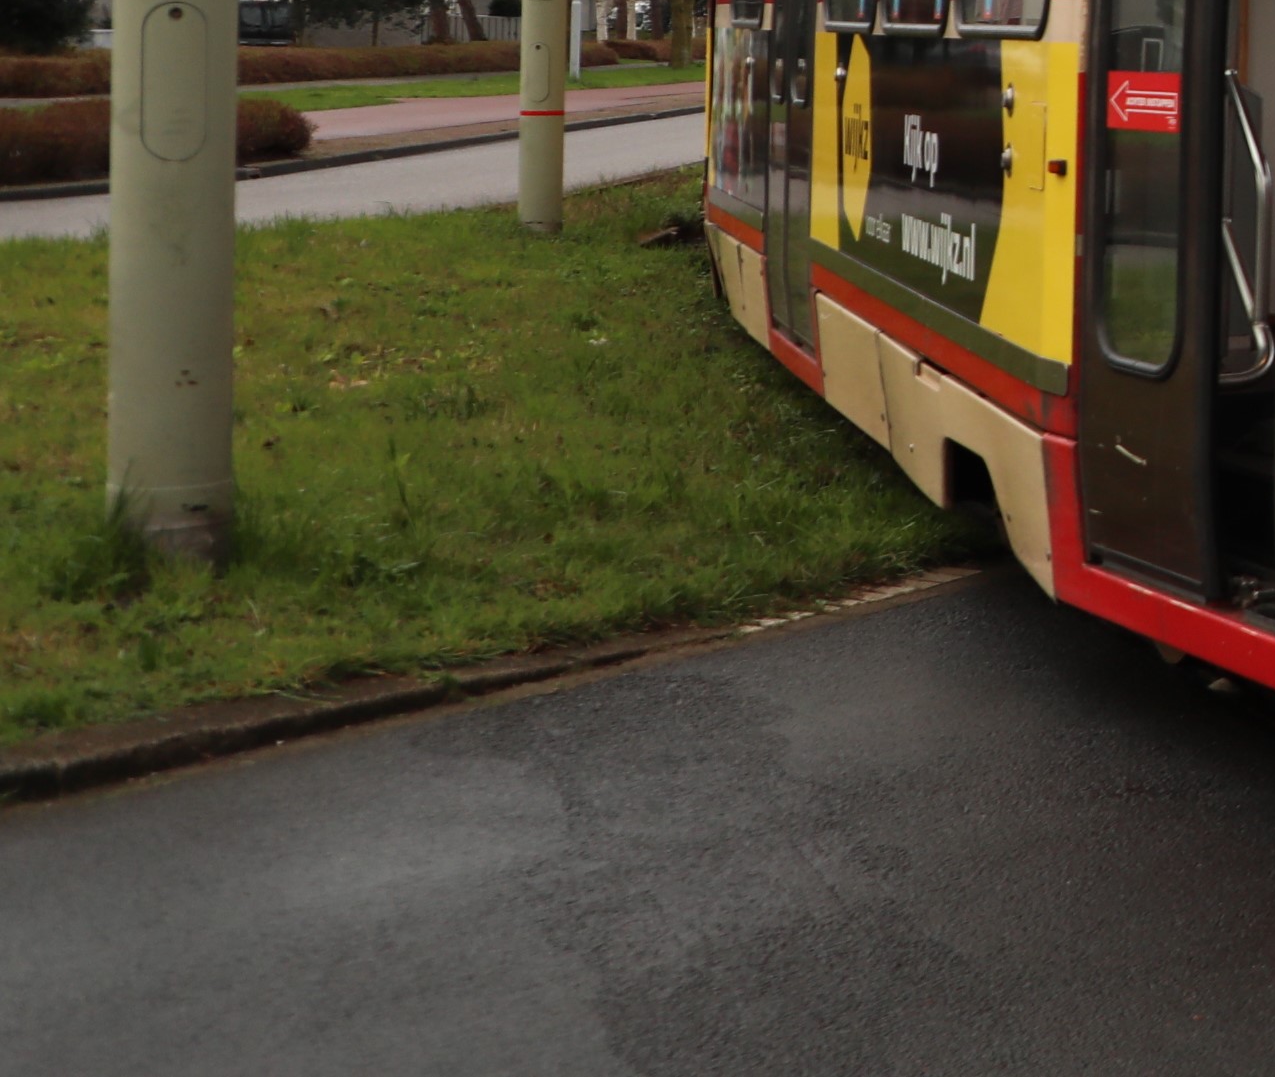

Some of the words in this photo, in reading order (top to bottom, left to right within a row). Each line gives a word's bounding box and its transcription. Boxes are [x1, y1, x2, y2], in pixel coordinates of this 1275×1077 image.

[903, 114, 923, 183] Kijk
[924, 131, 939, 189] op
[901, 211, 976, 285] www.wijkz.nl
